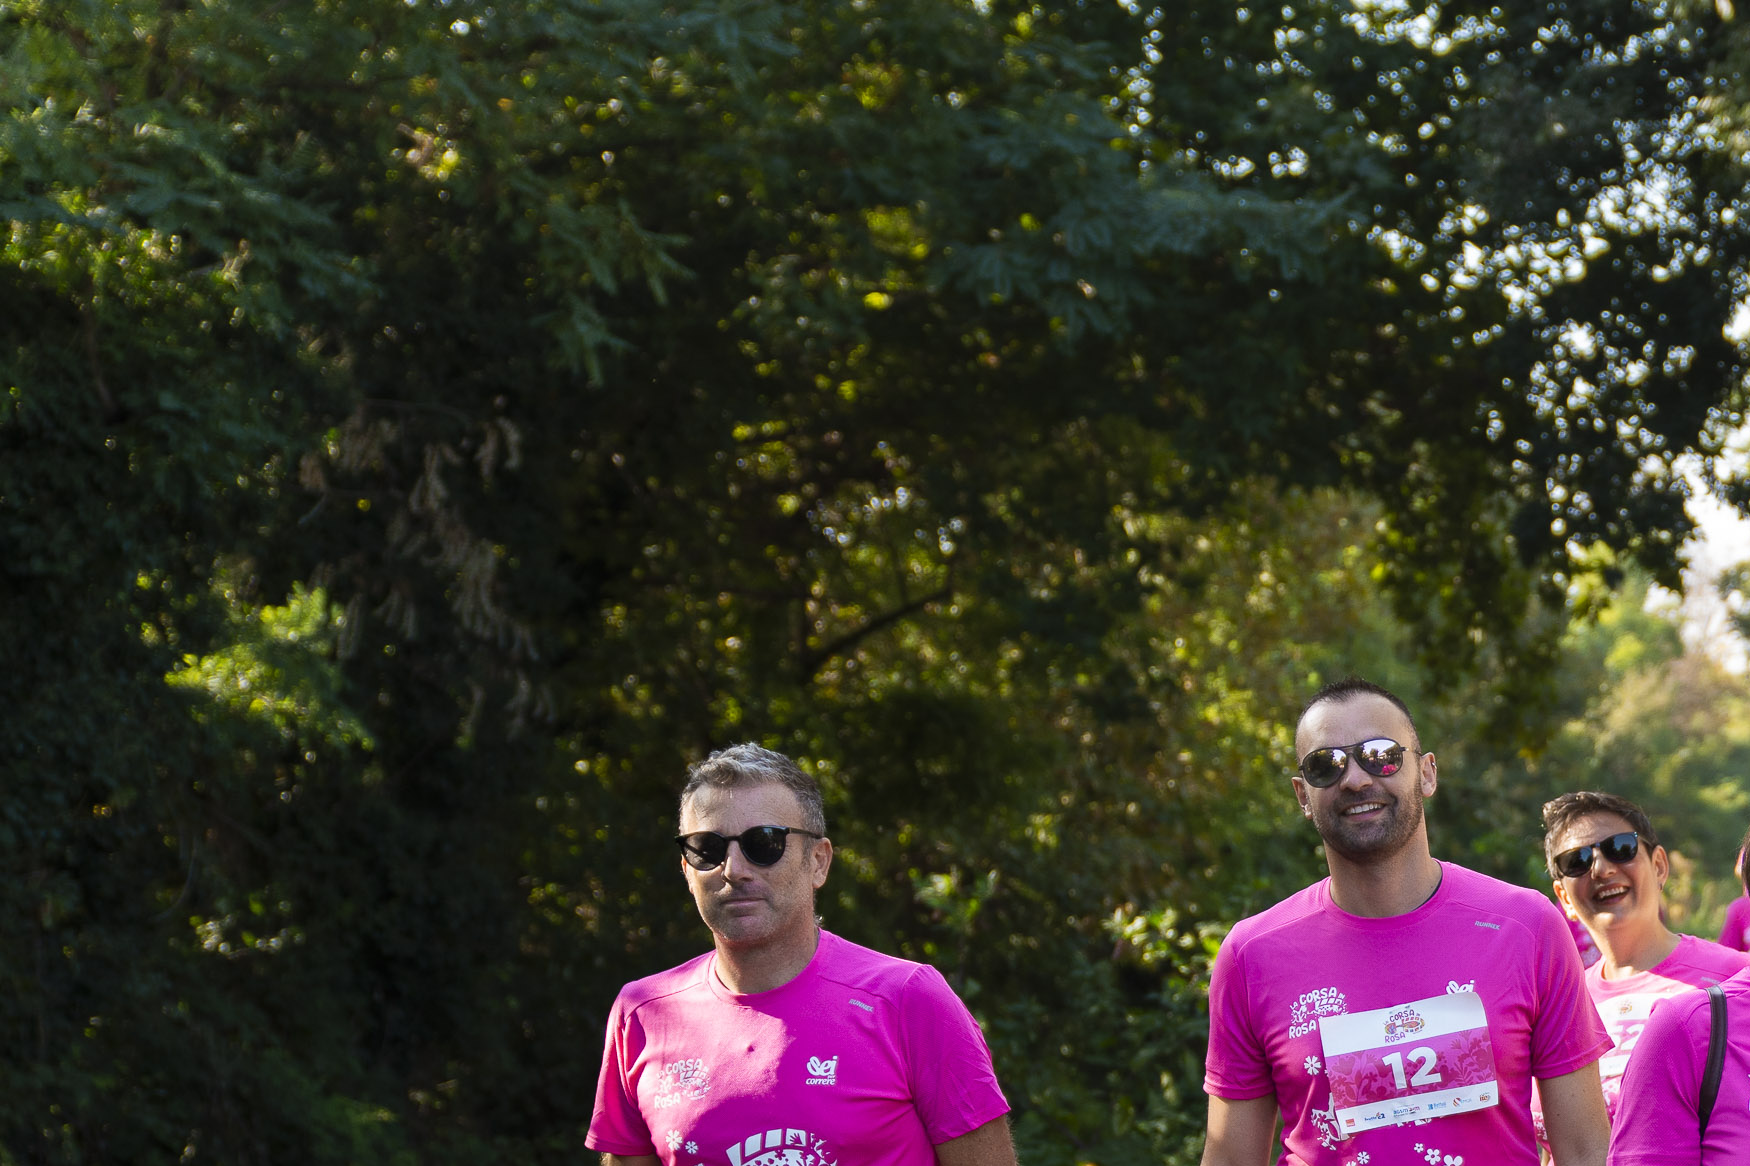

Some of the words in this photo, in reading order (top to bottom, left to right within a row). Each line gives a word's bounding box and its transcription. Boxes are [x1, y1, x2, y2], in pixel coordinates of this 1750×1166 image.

[1299, 986, 1337, 1006] CORSA
[1389, 1009, 1415, 1023] CORSA
[1288, 1019, 1317, 1039] ROSA
[1384, 1031, 1406, 1043] ROSA
[665, 1058, 702, 1074] CORSA
[1382, 1046, 1442, 1090] 12
[805, 1077, 836, 1086] correre
[654, 1092, 681, 1109] ROSA
